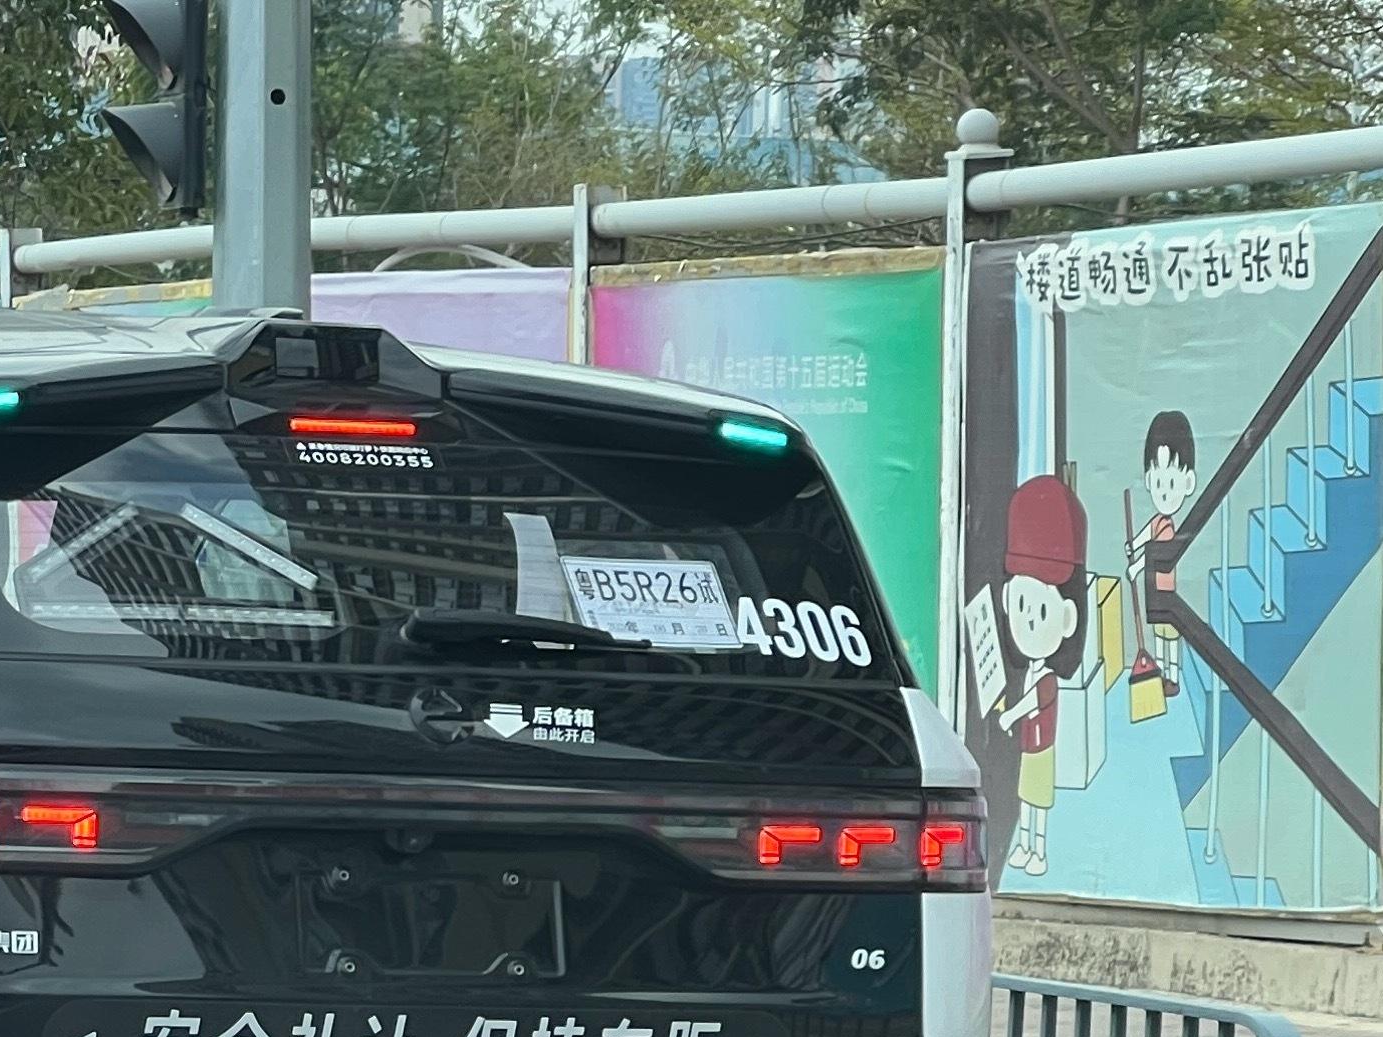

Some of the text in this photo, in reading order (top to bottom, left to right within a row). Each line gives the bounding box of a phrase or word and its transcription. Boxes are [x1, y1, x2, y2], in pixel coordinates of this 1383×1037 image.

[1026, 231, 1309, 302] 楼道畅通 不乱张贴
[299, 452, 434, 468] 4008200355
[575, 568, 720, 604] 粤B5R26试
[737, 597, 872, 666] 4306
[533, 707, 595, 728] 后备箱
[533, 727, 595, 744] 由此开启
[850, 949, 885, 970] 06
